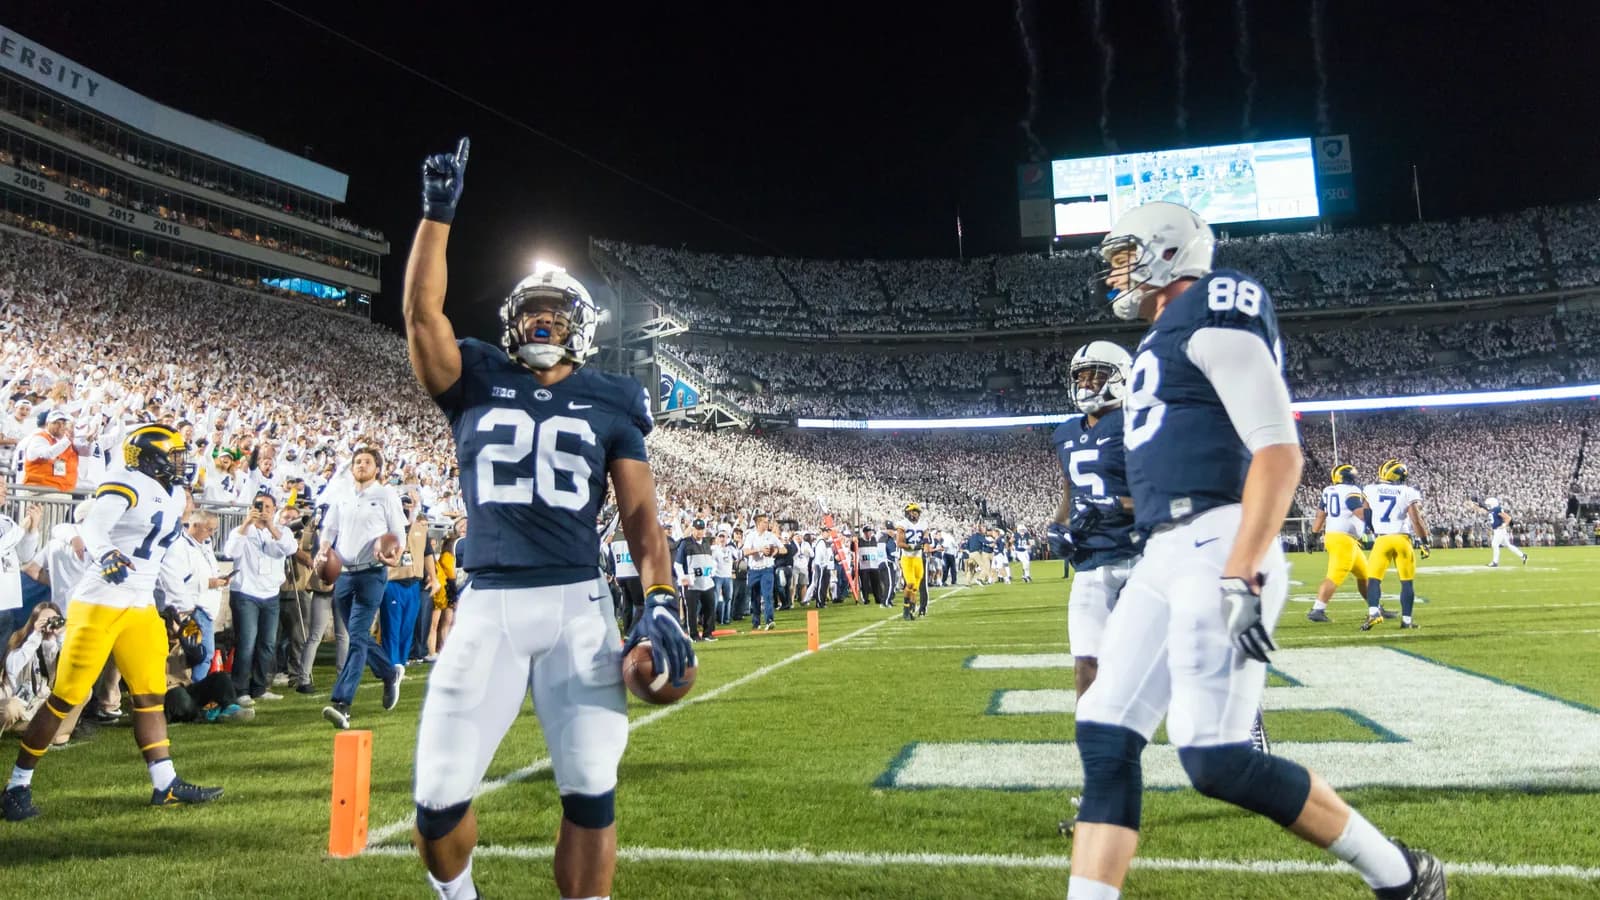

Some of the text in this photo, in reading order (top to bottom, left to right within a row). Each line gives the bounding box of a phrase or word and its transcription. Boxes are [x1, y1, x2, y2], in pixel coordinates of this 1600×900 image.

[0, 36, 99, 97] ERSITY
[14, 172, 181, 237] 2005 2008 2012 2016
[1208, 277, 1262, 317] 88
[476, 407, 597, 512] 26
[1069, 449, 1105, 496] 5
[1378, 495, 1397, 522] 7
[905, 529, 924, 544] 23
